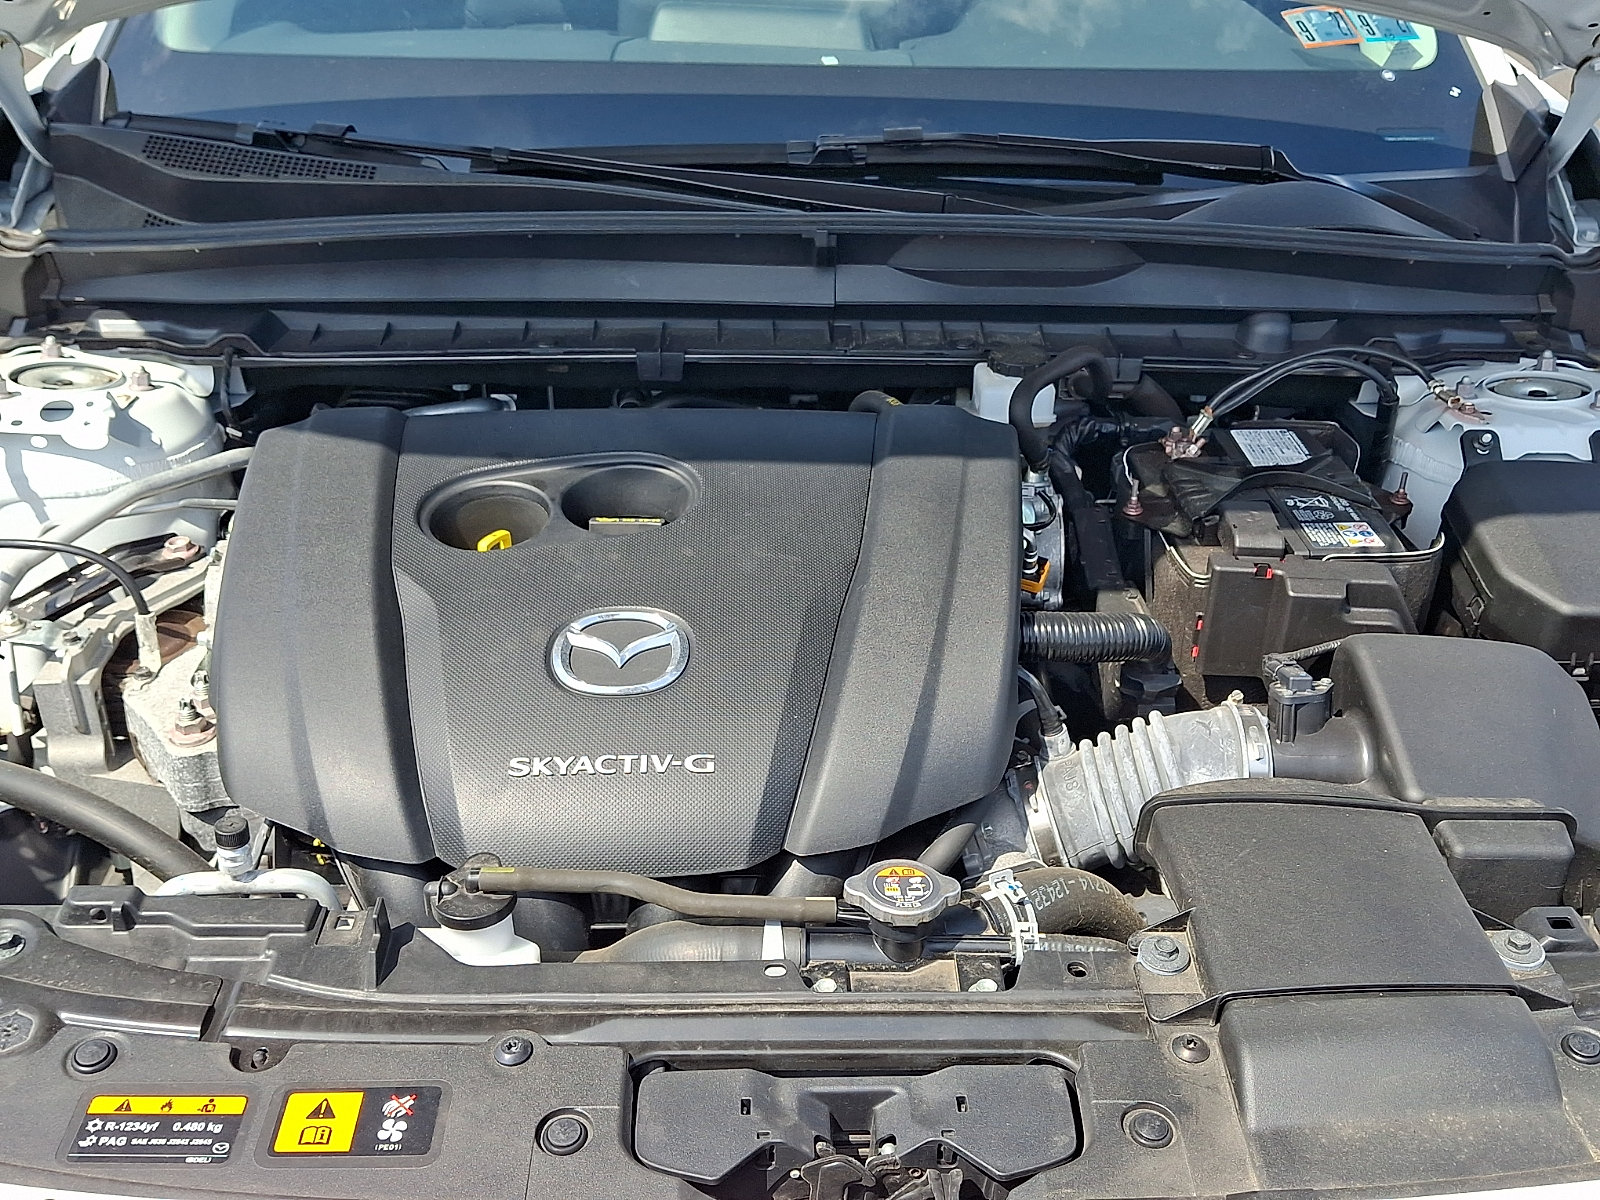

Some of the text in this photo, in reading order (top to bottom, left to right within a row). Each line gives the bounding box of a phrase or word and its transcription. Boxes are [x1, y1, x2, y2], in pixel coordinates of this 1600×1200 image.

[1296, 20, 1316, 42] 9
[1358, 14, 1376, 36] 9
[508, 754, 715, 777] SKYACTIV-G
[104, 1121, 160, 1133] R-1234yf
[206, 1121, 224, 1133] kg
[98, 1136, 127, 1147] PAG
